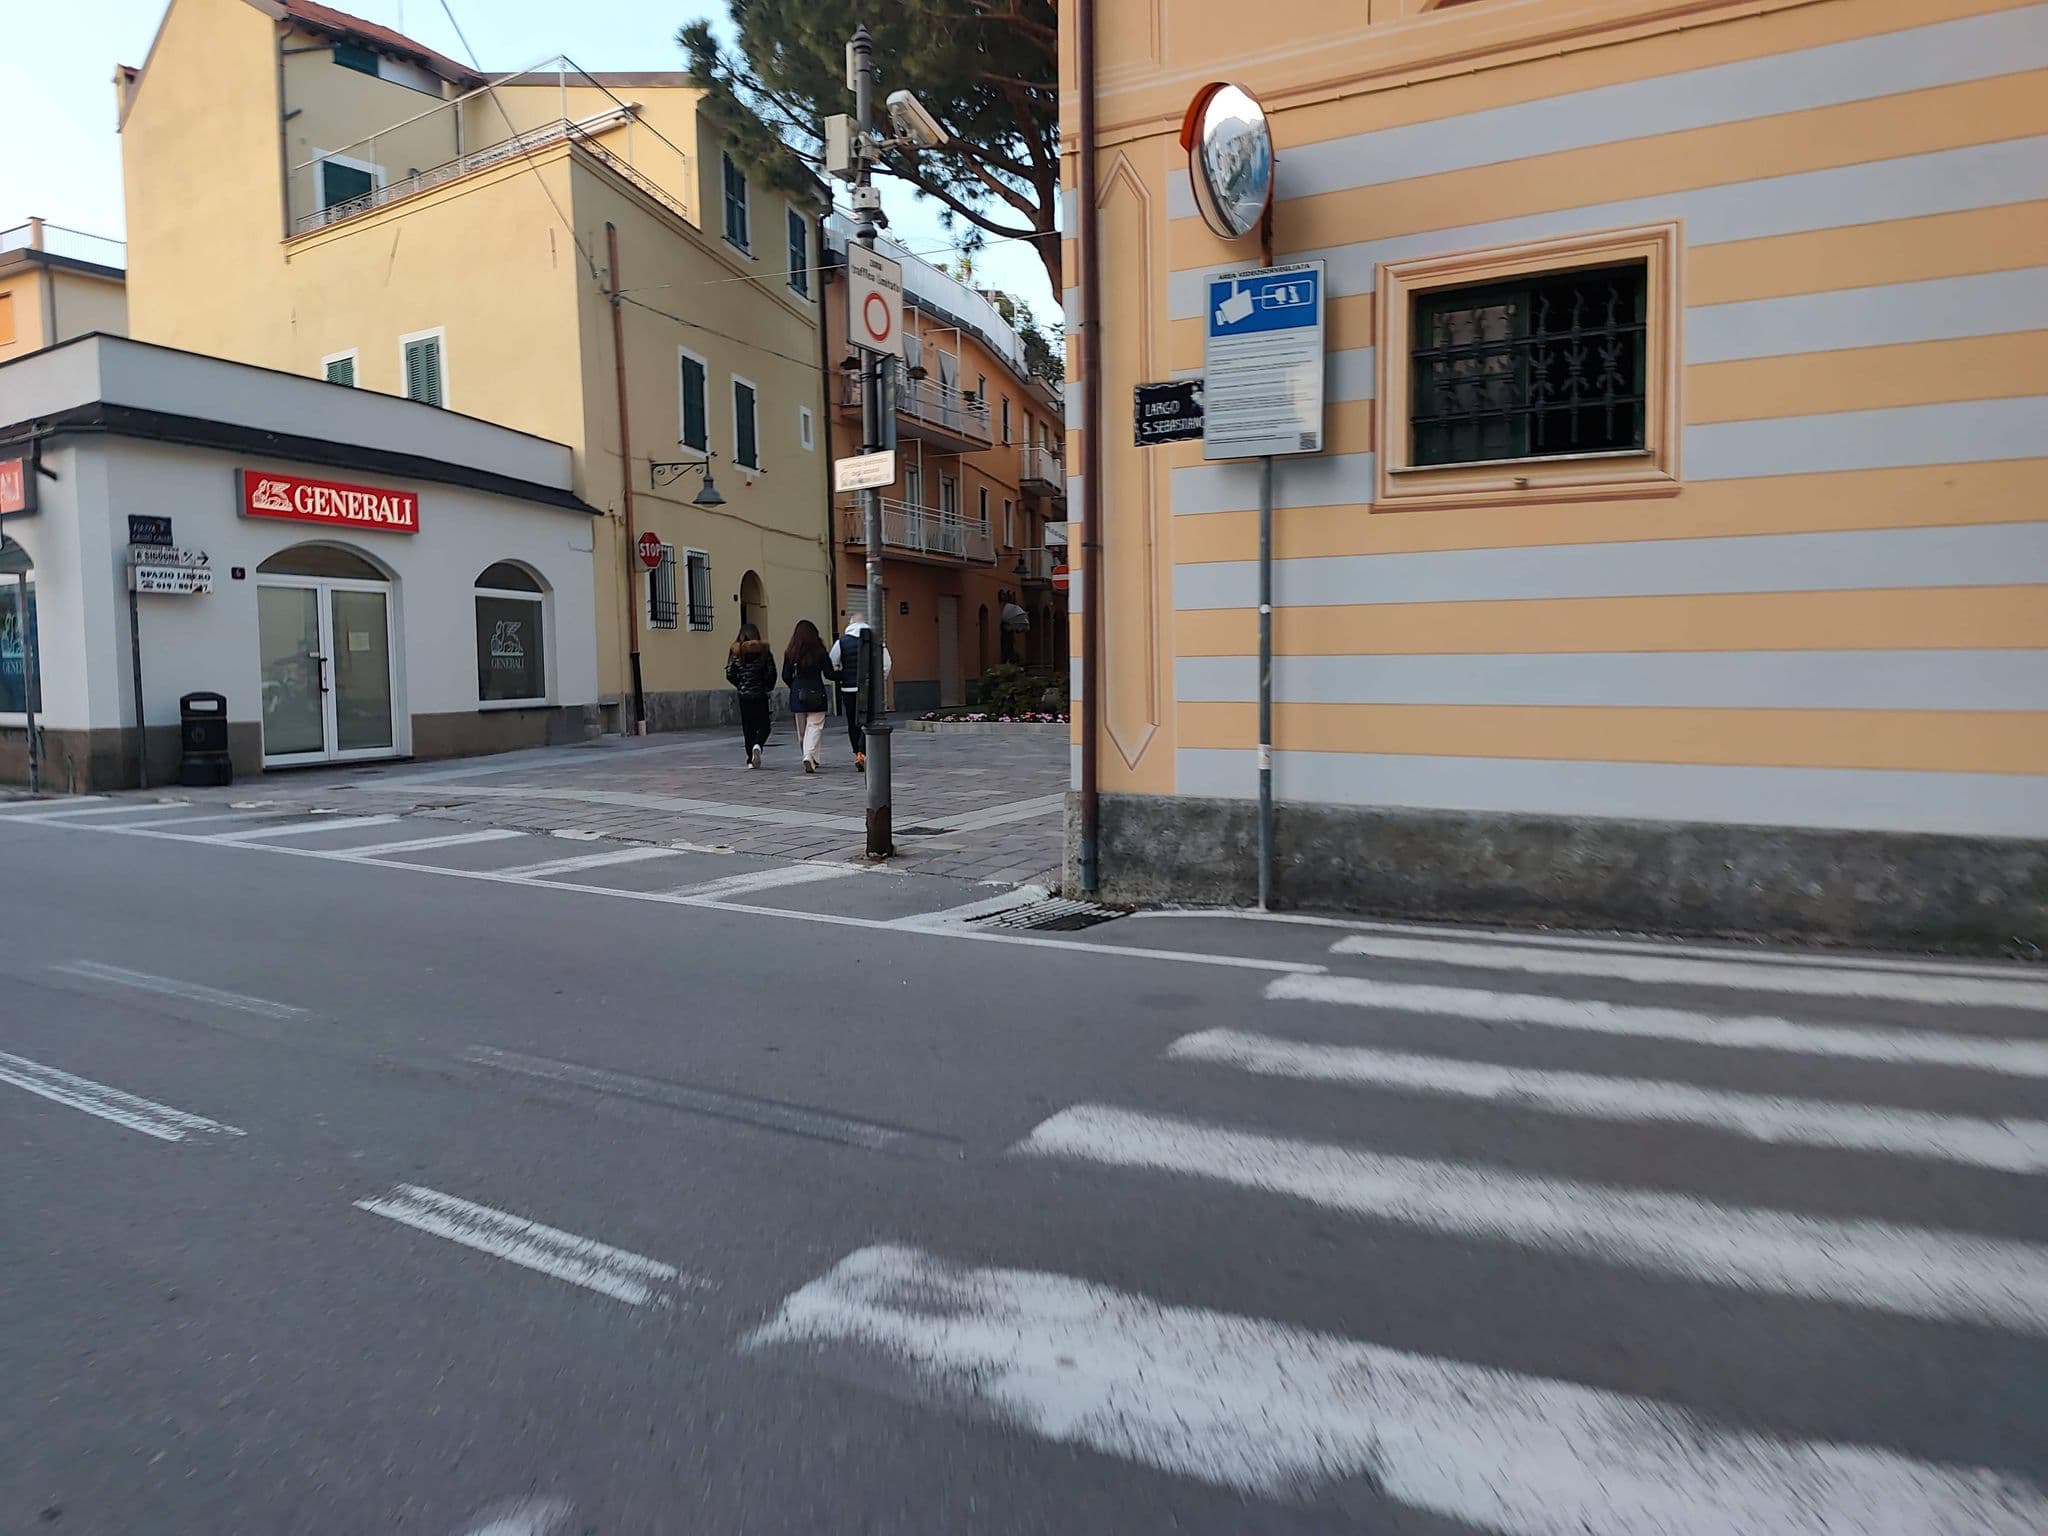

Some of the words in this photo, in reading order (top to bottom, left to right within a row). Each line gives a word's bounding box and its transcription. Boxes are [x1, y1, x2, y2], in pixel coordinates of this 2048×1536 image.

[1145, 400, 1180, 417] LARGO
[294, 485, 413, 526] GENERALI
[640, 543, 662, 557] STOP
[140, 571, 175, 580] SPAZIO
